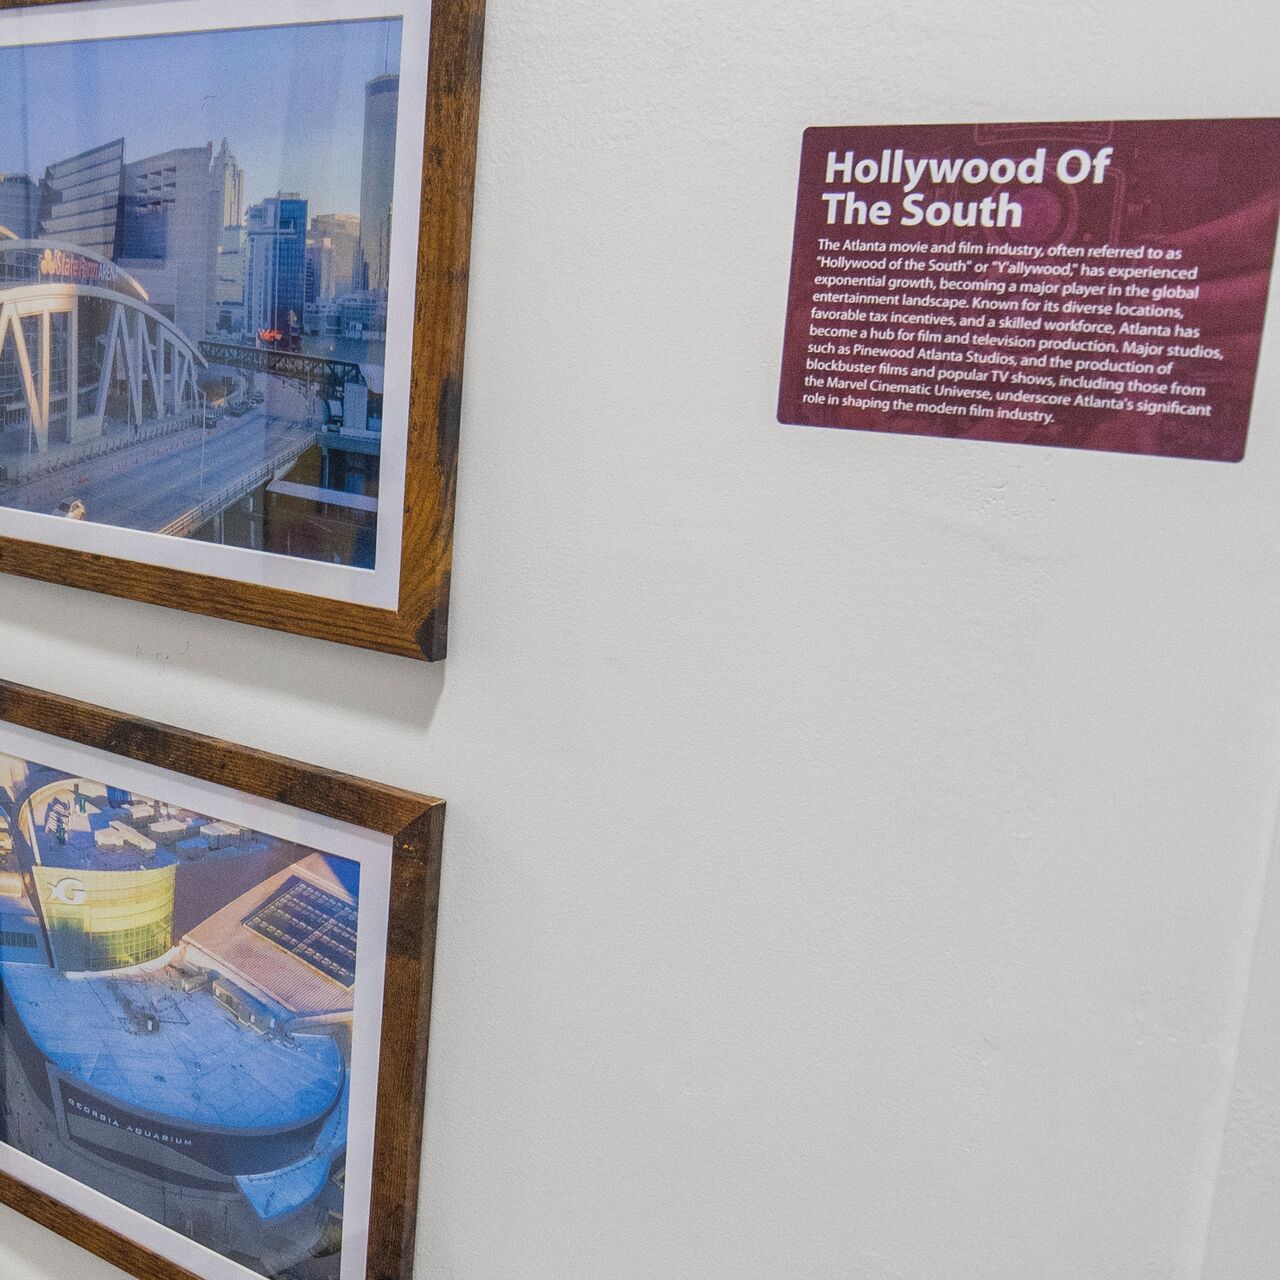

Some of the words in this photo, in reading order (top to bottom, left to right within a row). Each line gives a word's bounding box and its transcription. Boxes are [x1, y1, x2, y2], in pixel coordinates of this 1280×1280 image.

[825, 148, 1046, 192] Hollywood
[1057, 147, 1114, 184] Of
[821, 192, 891, 226] The
[900, 193, 1023, 228] South
[818, 239, 840, 250] The
[843, 240, 886, 252] Atlanta
[889, 241, 928, 253] movie
[931, 241, 956, 254] and
[958, 242, 983, 254] film
[986, 242, 1044, 259] industry,
[1047, 244, 1084, 257] often
[1087, 245, 1144, 259] referred
[1147, 247, 1163, 259] to
[1166, 249, 1182, 260] as
[890, 258, 902, 270] of
[905, 259, 925, 271] the
[974, 262, 988, 272] or
[1081, 264, 1105, 277] has
[1108, 266, 1198, 281] experienced
[815, 274, 886, 288] exponential
[888, 277, 936, 290] growth,
[939, 278, 1005, 294] becoming
[1009, 283, 1017, 292] a
[1020, 282, 1059, 295] major
[1062, 283, 1105, 298] player
[1108, 284, 1122, 296] in
[1125, 285, 1149, 298] the
[1152, 286, 1199, 301] global
[811, 307, 867, 321] favorable
[870, 311, 888, 322] tax
[891, 311, 956, 326] incentives,
[960, 315, 985, 328] and
[987, 319, 995, 328] a
[999, 315, 1041, 330] skilled
[1044, 318, 1115, 335] workforce,
[1119, 321, 1170, 337] Atlanta
[1174, 324, 1200, 338] has
[813, 293, 899, 306] entertainment
[902, 294, 969, 309] landscape.
[972, 298, 1018, 311] Known
[1022, 299, 1040, 311] for
[1043, 300, 1060, 312] its
[1062, 301, 1113, 315] diverse
[1115, 303, 1183, 320] locations,
[807, 341, 835, 354] such
[838, 346, 850, 355] as
[853, 345, 914, 359] Pinewood
[917, 348, 962, 362] Atlanta
[966, 351, 1017, 367] Studios,
[1021, 354, 1047, 367] and
[1050, 355, 1073, 368] the
[1075, 358, 1154, 374] production
[1157, 362, 1174, 374] of
[809, 324, 858, 338] become
[860, 330, 867, 339] a
[870, 327, 895, 340] hub
[897, 330, 915, 341] for
[918, 330, 941, 343] film
[944, 331, 969, 344] and
[972, 334, 1035, 348] television
[1038, 336, 1119, 353] production.
[1122, 341, 1164, 357] Major
[1167, 344, 1223, 361] studios,
[806, 358, 876, 373] blockbuster
[879, 362, 908, 376] films
[911, 364, 935, 378] and
[938, 367, 988, 382] popular
[991, 370, 1008, 382] TV
[1011, 372, 1056, 387] shows,
[1059, 374, 1124, 393] including
[1127, 379, 1168, 394] those
[1170, 383, 1206, 396] from
[803, 393, 825, 404] role
[828, 394, 839, 405] in
[842, 395, 890, 411] shaping
[893, 400, 913, 411] the
[916, 402, 966, 416] modern
[969, 404, 994, 418] film
[997, 406, 1054, 424] industry.
[804, 375, 824, 387] the
[827, 376, 867, 390] Marvel
[870, 380, 931, 396] Cinematic
[934, 386, 993, 401] Universe,
[996, 389, 1071, 406] underscore
[1137, 398, 1212, 416] significant
[68, 1098, 120, 1127] GEORGIA
[126, 1125, 193, 1146] AQUARIUM
